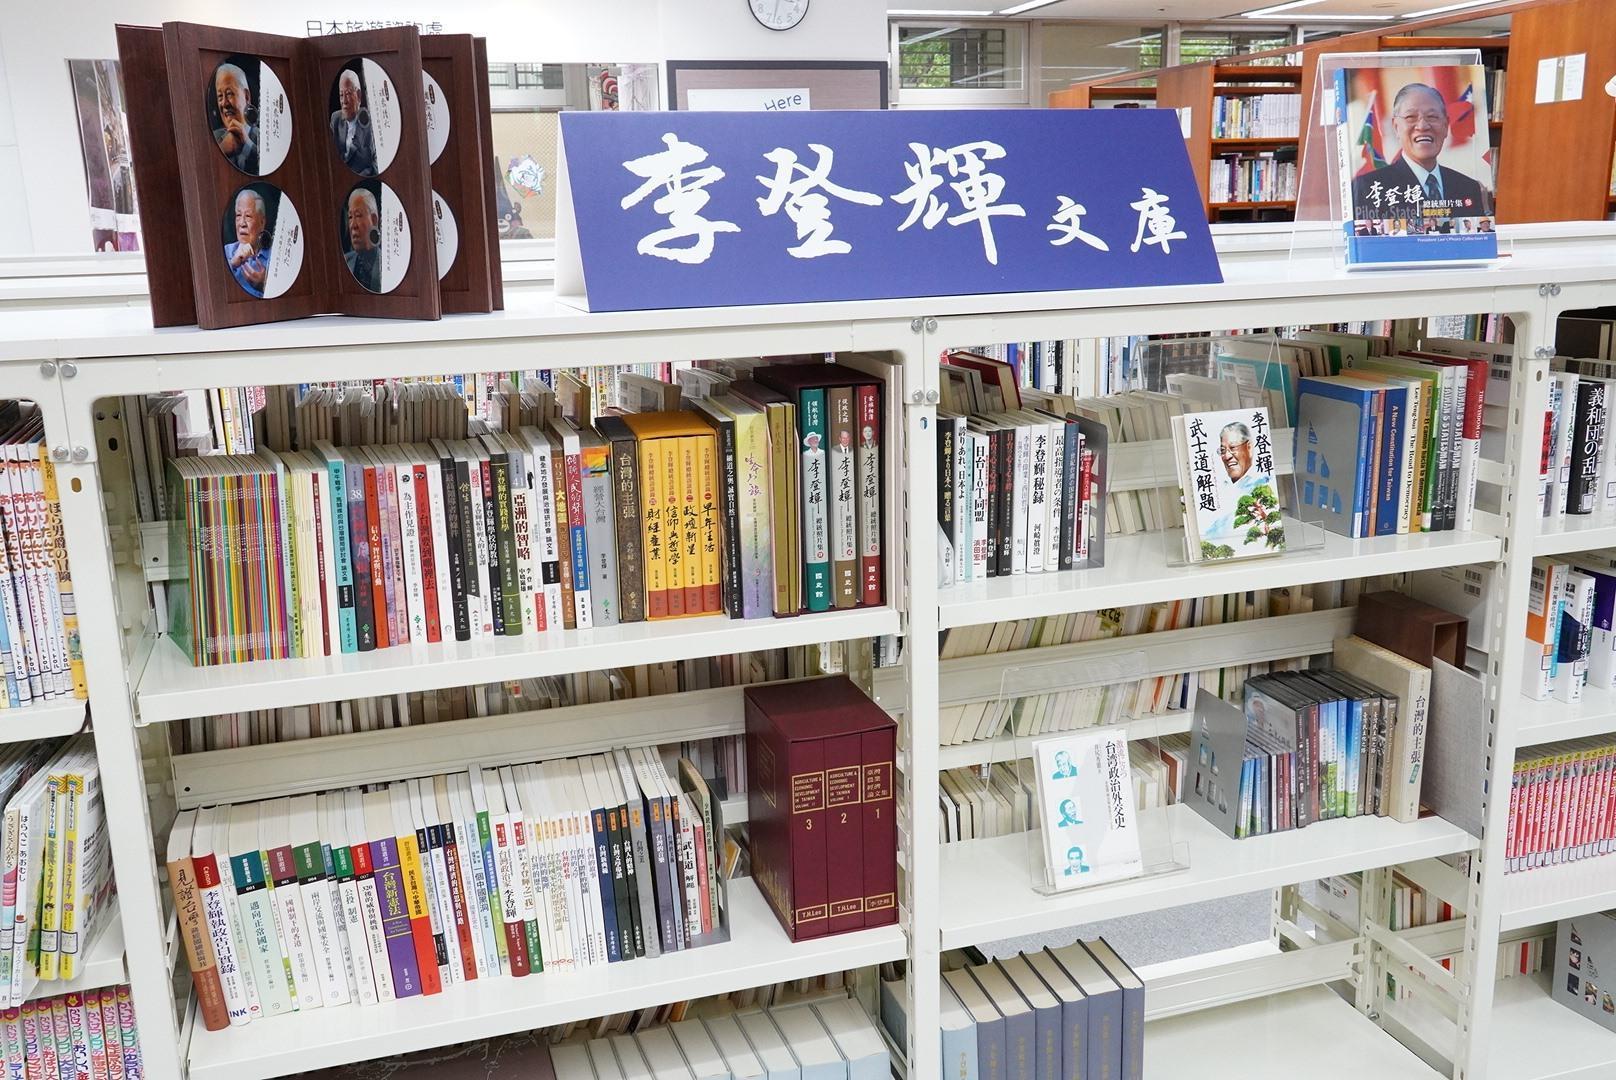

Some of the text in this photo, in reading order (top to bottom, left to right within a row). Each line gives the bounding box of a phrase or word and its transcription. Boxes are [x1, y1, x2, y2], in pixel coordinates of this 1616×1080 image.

[764, 94, 802, 111] Here
[1366, 180, 1425, 217] 李登輝
[1251, 411, 1274, 476] 李登輝
[1582, 387, 1604, 475] 義和団の乱
[1033, 434, 1046, 505] 李登輝秘録
[1189, 418, 1217, 512] 武士道解題
[350, 489, 362, 499] 38
[620, 453, 636, 519] 台灣的主張
[514, 493, 530, 560] 亞洲的智略
[700, 502, 717, 553] 早年生活
[815, 572, 824, 598] 國史館
[844, 570, 852, 595] 國史館
[868, 566, 877, 591] 國史館
[1411, 695, 1426, 764] 台灣的主張
[1105, 741, 1126, 829] 台湾政治外交史
[806, 818, 813, 830] 3
[840, 812, 848, 824] 2
[875, 808, 880, 819] 1
[504, 889, 517, 918] 李登輝
[229, 1007, 248, 1018] INK
